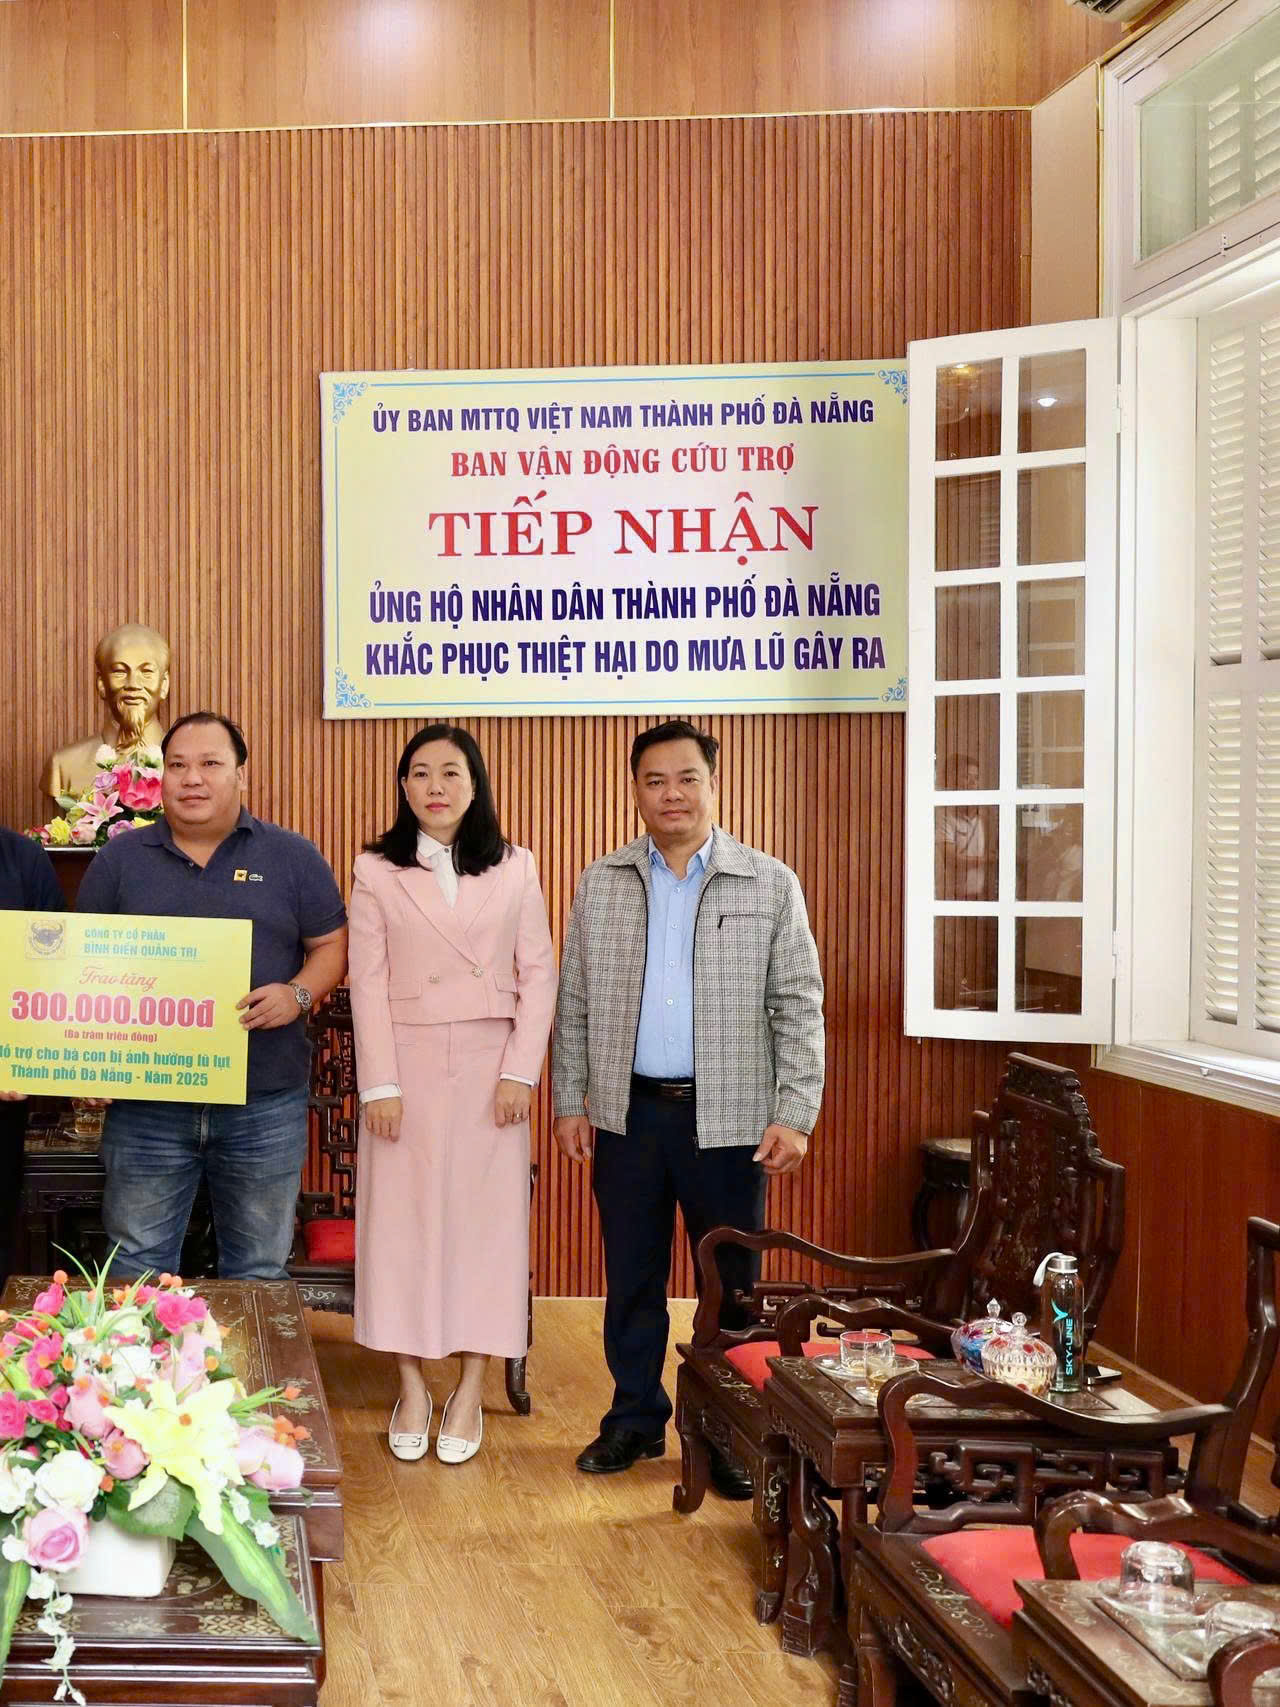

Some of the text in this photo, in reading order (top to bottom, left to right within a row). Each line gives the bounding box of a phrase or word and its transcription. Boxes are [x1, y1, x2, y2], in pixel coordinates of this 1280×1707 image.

[374, 392, 873, 434] ỦY BAN MTTQ VIỆT NAM THÀNH PHỐ ĐÀ NẴNG
[452, 442, 794, 479] BAN VẬN ĐỘNG CỨU TRỢ
[429, 490, 819, 565] TIẾP NHẬN
[370, 572, 880, 625] ỦNG HỘ NHÂN DÂN THÀNH PHỐ ĐÀ NẴNG
[367, 631, 885, 681] KHẮC PHỤC THIỆT HẠI DO MƯA LŨ GÂY RA
[37, 1048, 59, 1060] cho
[83, 1051, 106, 1062] con
[177, 1072, 208, 1086] 2025
